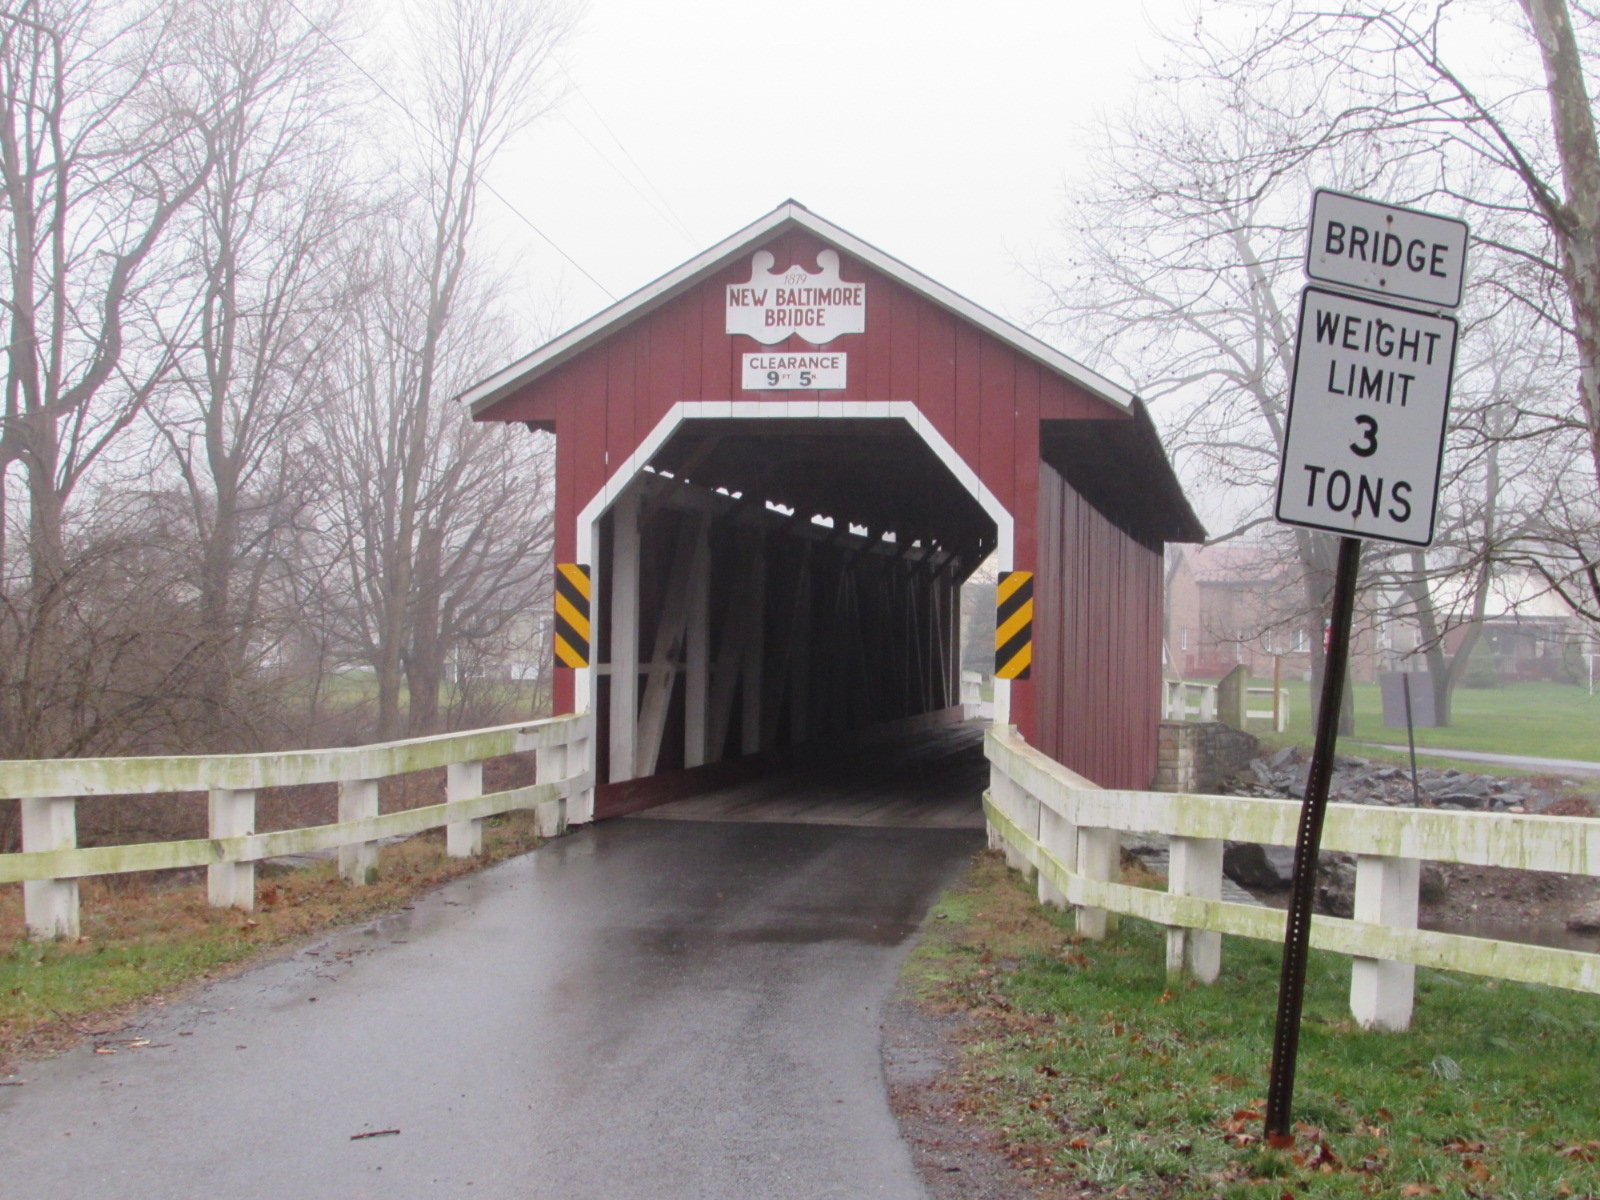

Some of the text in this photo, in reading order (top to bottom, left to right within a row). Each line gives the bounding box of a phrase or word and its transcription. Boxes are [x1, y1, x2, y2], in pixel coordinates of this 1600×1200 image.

[1325, 220, 1449, 278] BRIDGE
[784, 273, 807, 285] 1879
[729, 287, 862, 306] NEW BALTIMORE
[765, 308, 826, 327] BRIDGE
[1316, 309, 1441, 365] WEIGHT
[749, 357, 840, 369] CLEARANCE
[767, 370, 780, 386] 9
[799, 371, 812, 386] 5
[1328, 360, 1415, 407] LIMIT
[1350, 414, 1378, 457] 3
[1304, 464, 1412, 523] TONS
